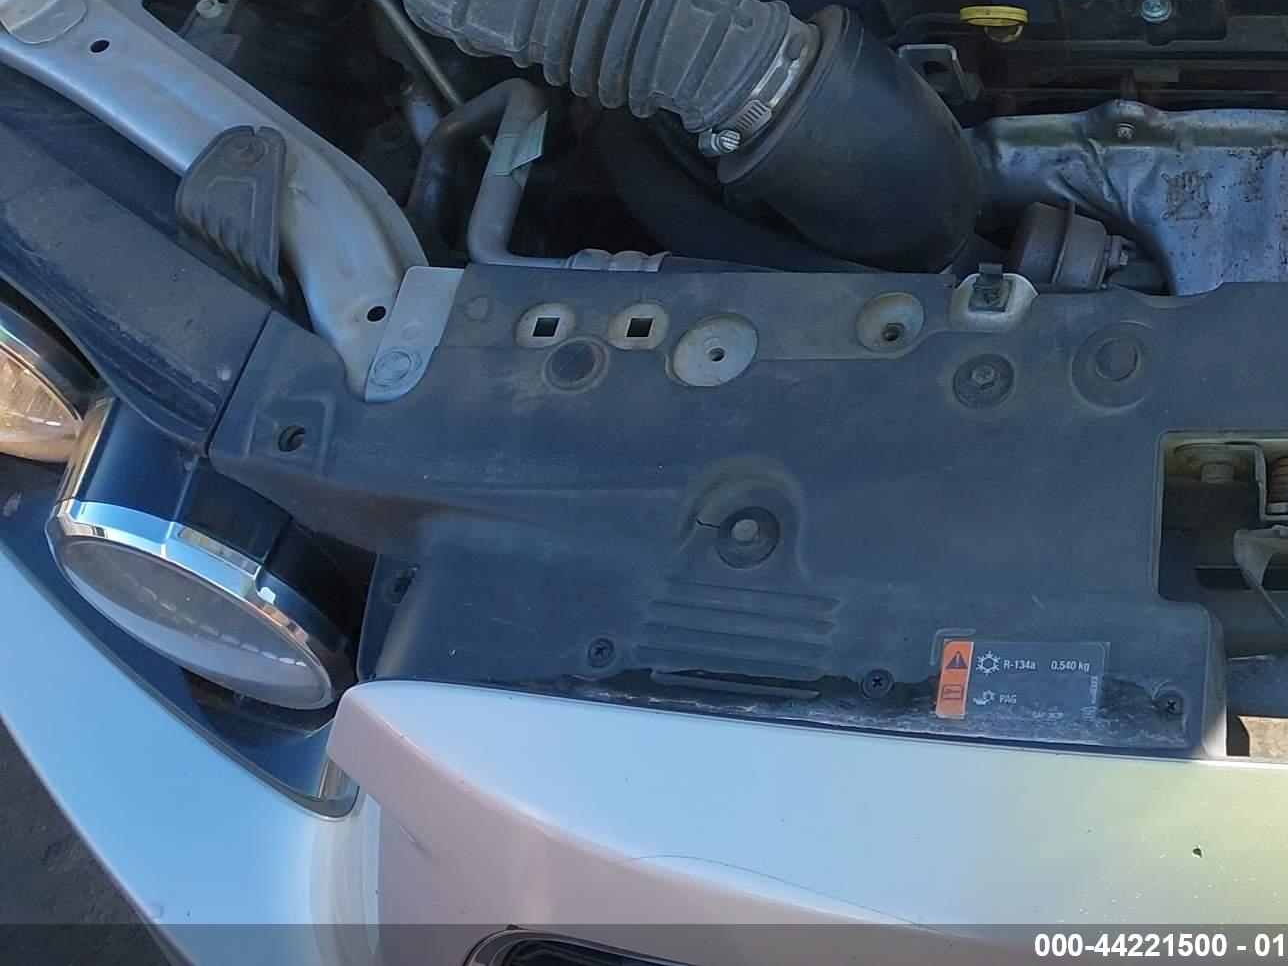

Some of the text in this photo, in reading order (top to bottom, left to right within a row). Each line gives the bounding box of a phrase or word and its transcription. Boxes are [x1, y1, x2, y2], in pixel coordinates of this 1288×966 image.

[1003, 659, 1090, 673] R-134a 0.540 kg
[999, 694, 1017, 704] PAG
